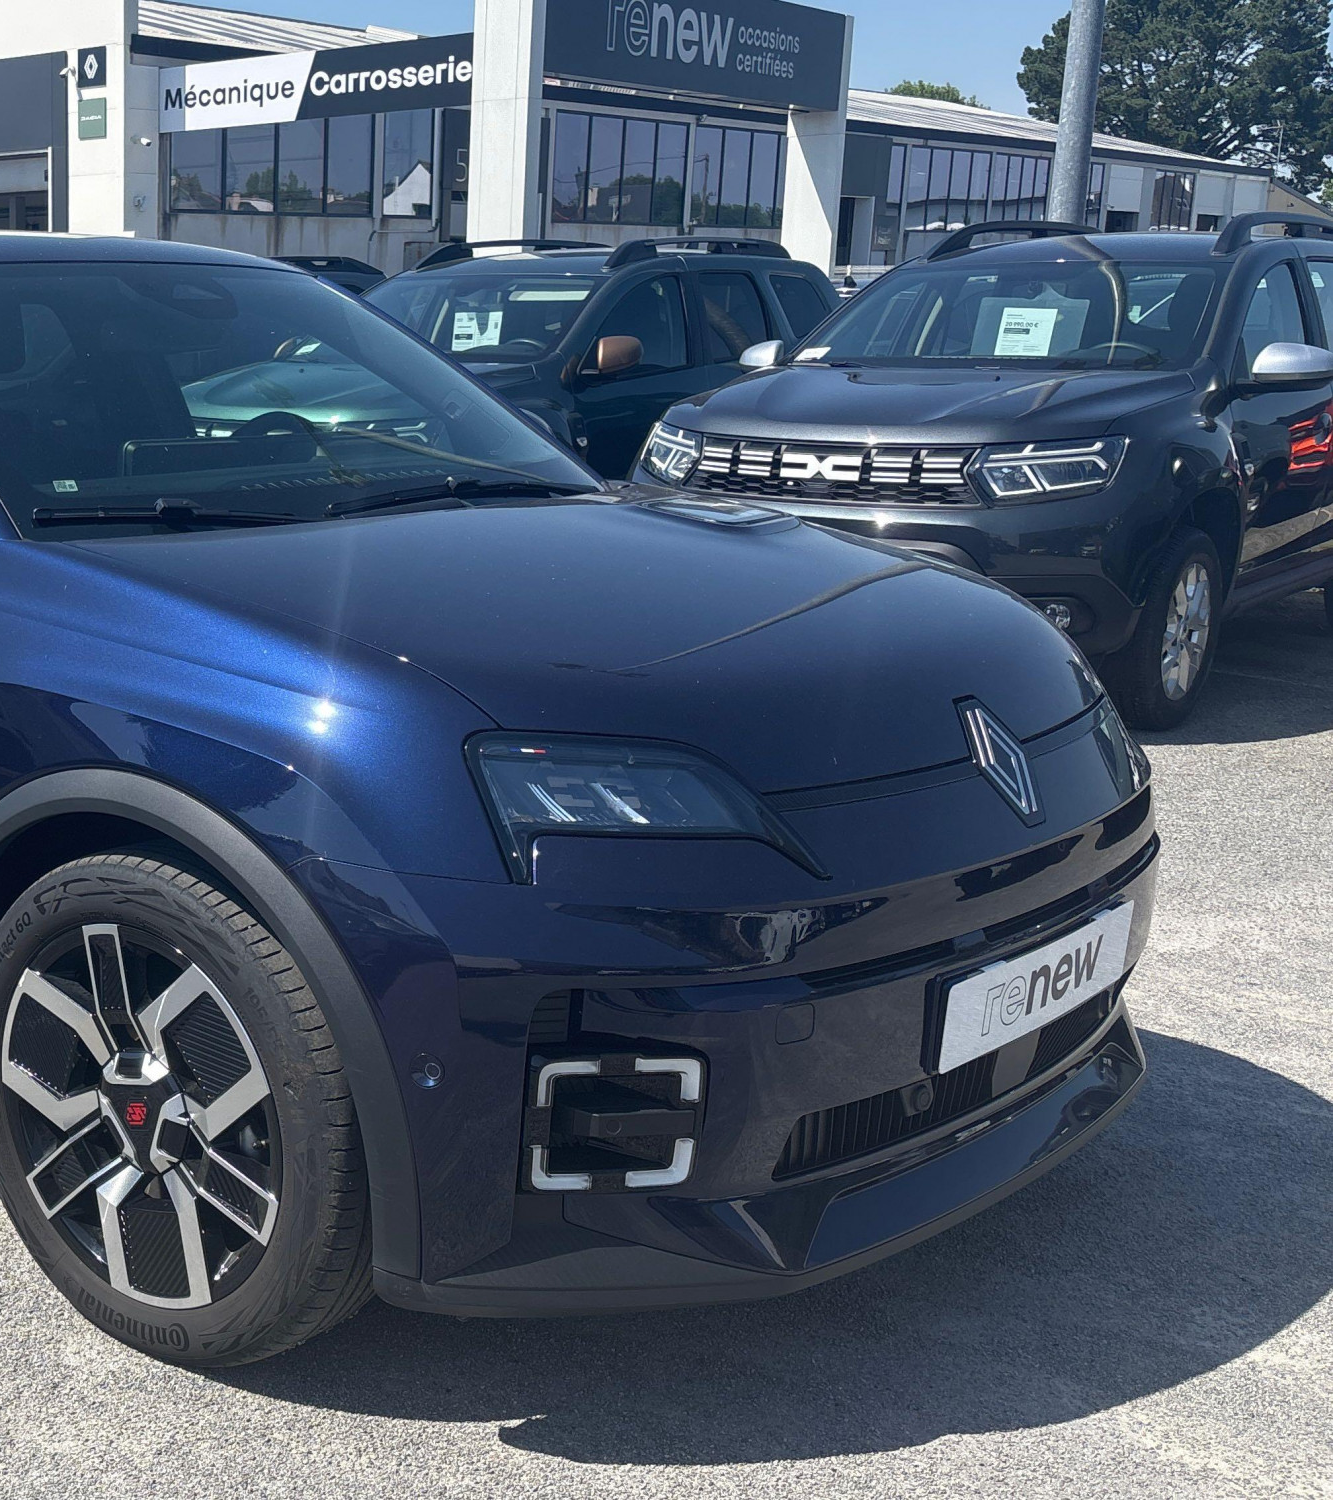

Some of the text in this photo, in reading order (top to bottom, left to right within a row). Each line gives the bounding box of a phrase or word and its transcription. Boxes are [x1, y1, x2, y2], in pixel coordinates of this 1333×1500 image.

[607, 0, 734, 68] renew
[738, 26, 800, 54] occasions
[309, 55, 473, 97] Carrosserie
[736, 53, 794, 79] certifiées
[164, 78, 295, 111] Mécanique
[456, 148, 468, 182] 5
[981, 934, 1104, 1037] renew
[77, 1286, 190, 1352] Continental
